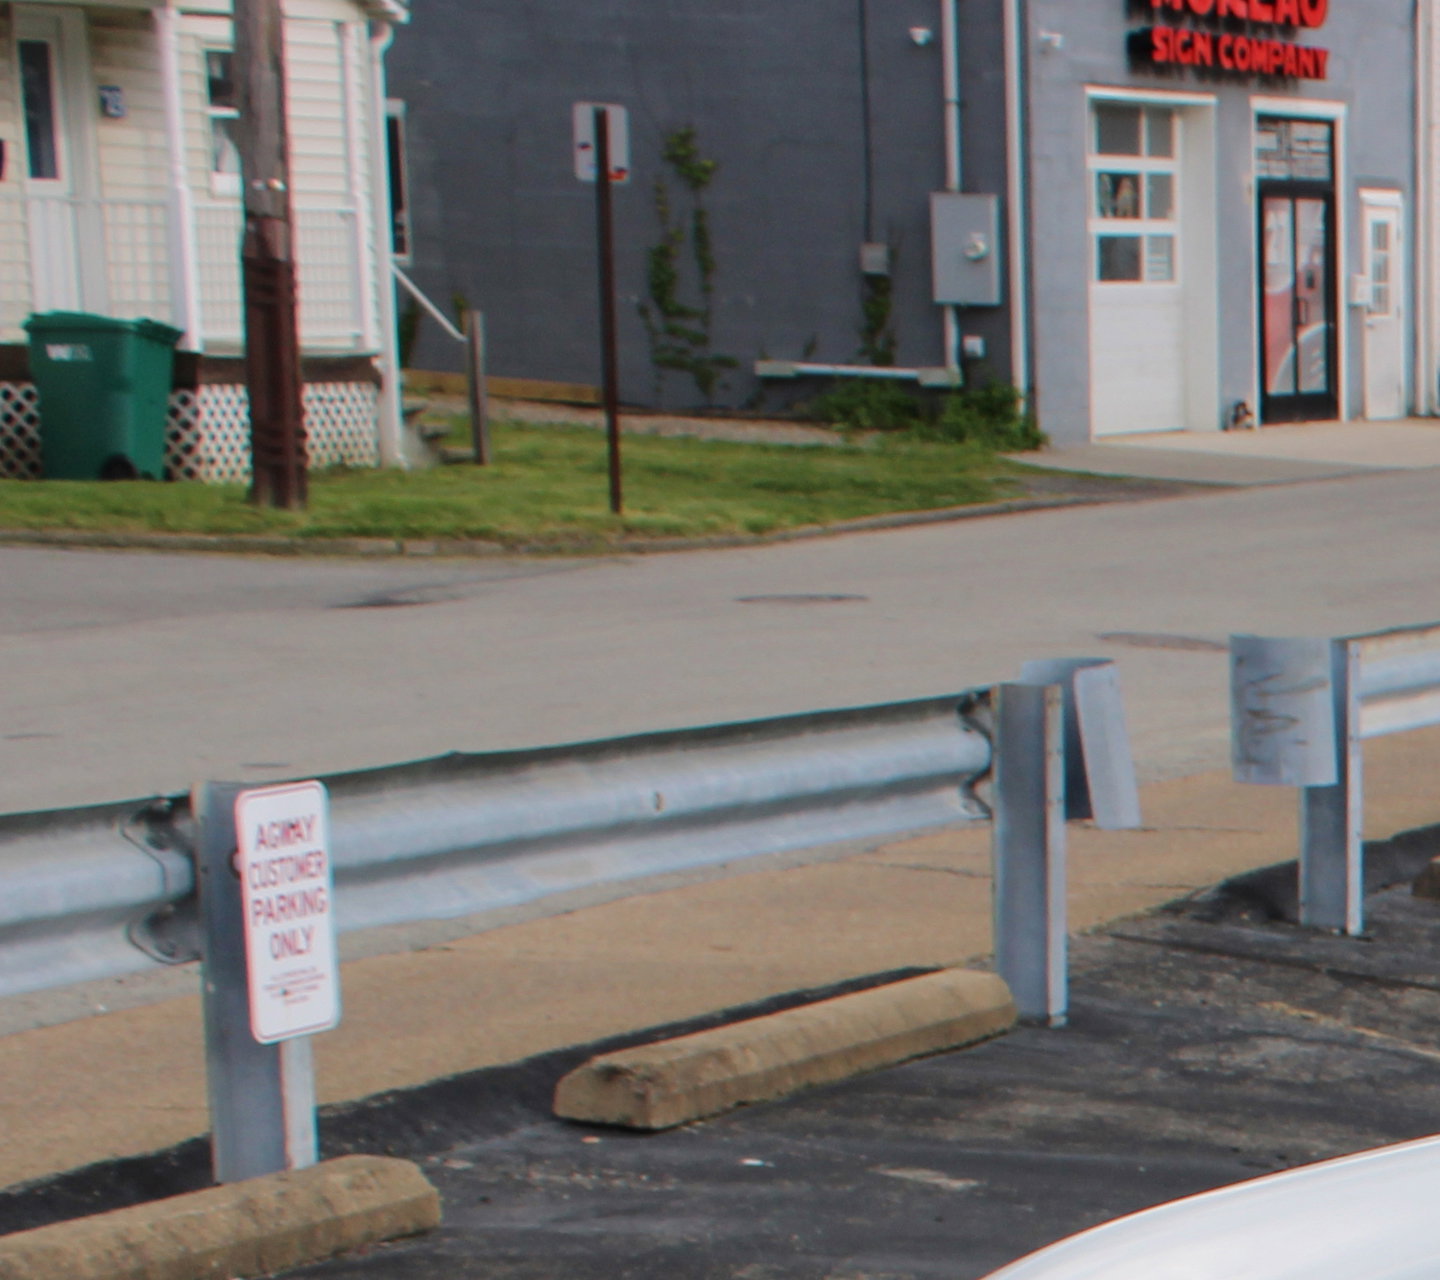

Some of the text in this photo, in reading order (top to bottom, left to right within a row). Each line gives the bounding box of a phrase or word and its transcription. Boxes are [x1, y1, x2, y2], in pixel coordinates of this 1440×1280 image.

[1151, 25, 1329, 80] SIGN COMPANY
[255, 814, 318, 851] AGWAY
[250, 850, 326, 890] CUSTOMER
[252, 886, 329, 927] PARKING
[271, 924, 316, 960] ONLY
